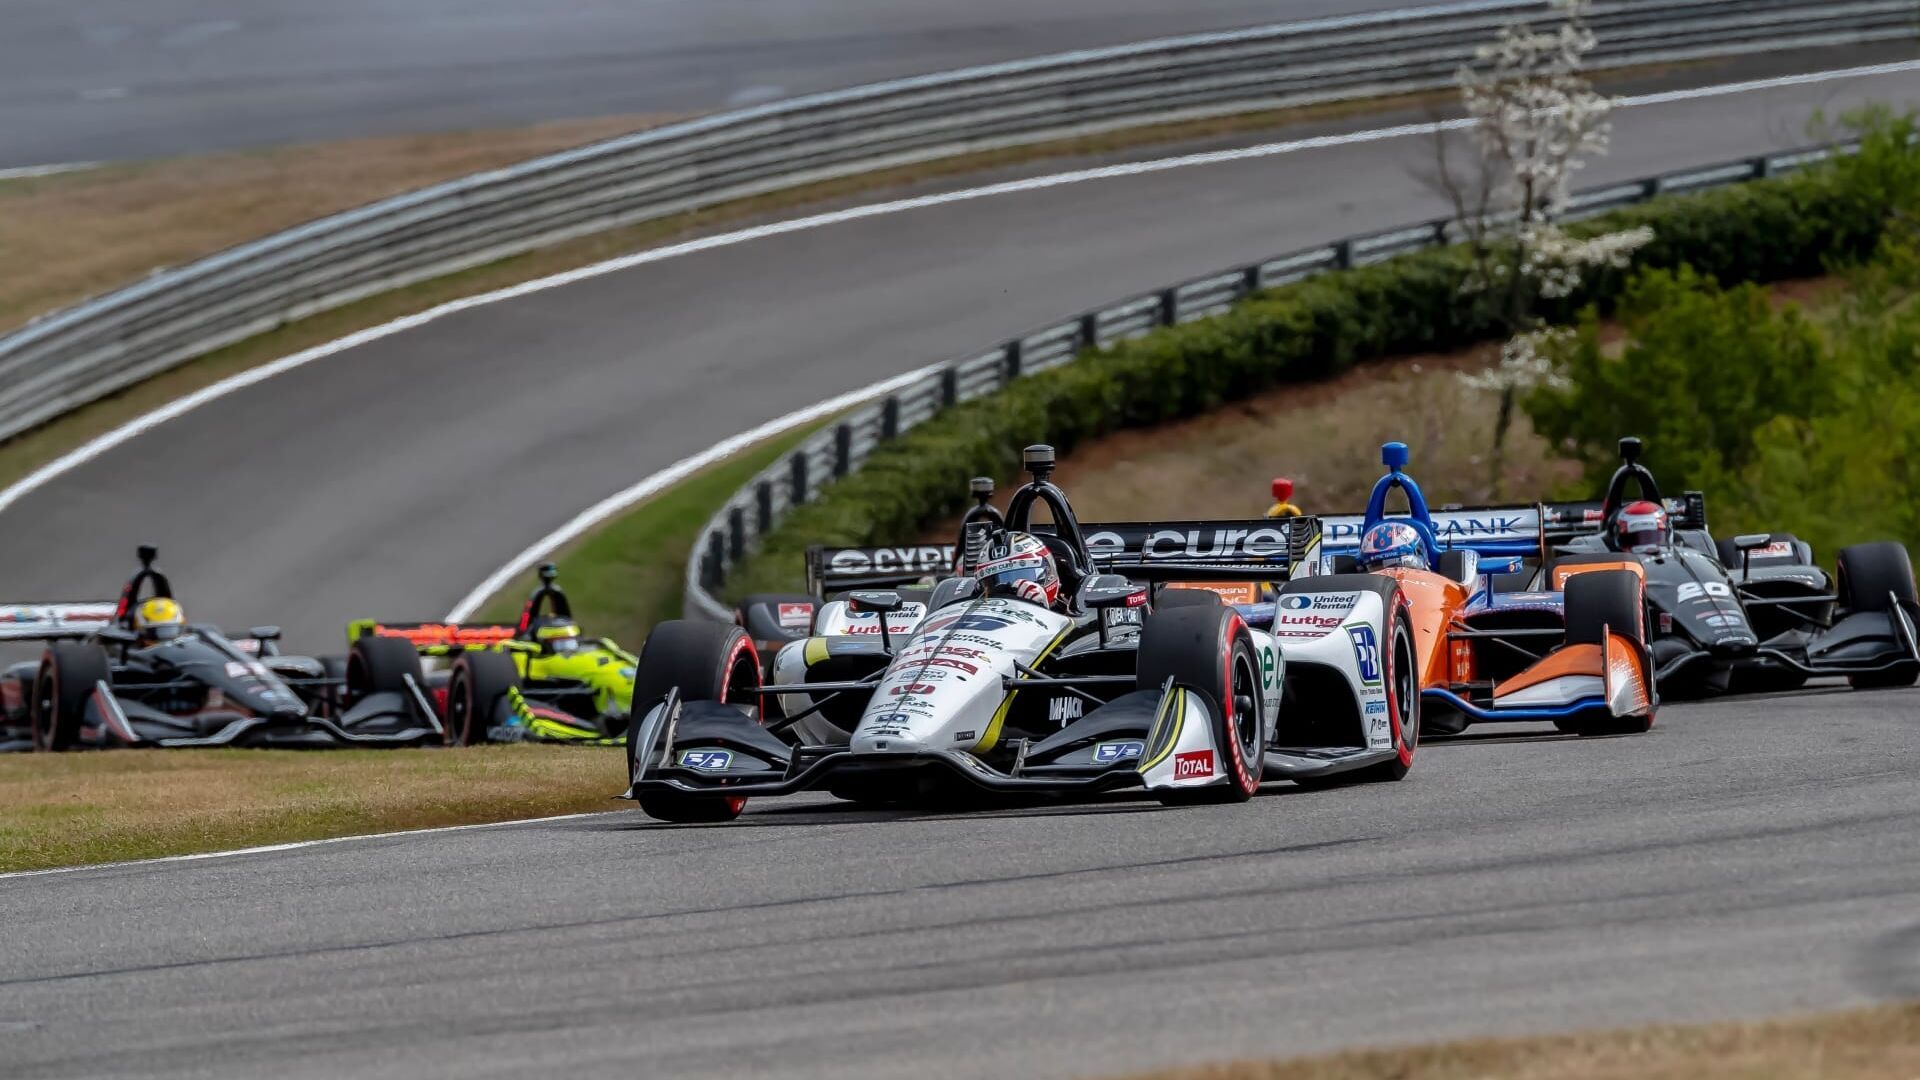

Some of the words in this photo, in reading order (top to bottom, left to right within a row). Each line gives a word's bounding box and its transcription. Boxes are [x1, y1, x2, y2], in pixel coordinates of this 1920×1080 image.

[1146, 528, 1287, 558] cure
[1313, 595, 1356, 603] United
[1312, 602, 1355, 610] Rentals
[848, 624, 909, 635] Luter
[1176, 757, 1212, 776] TOTAL
